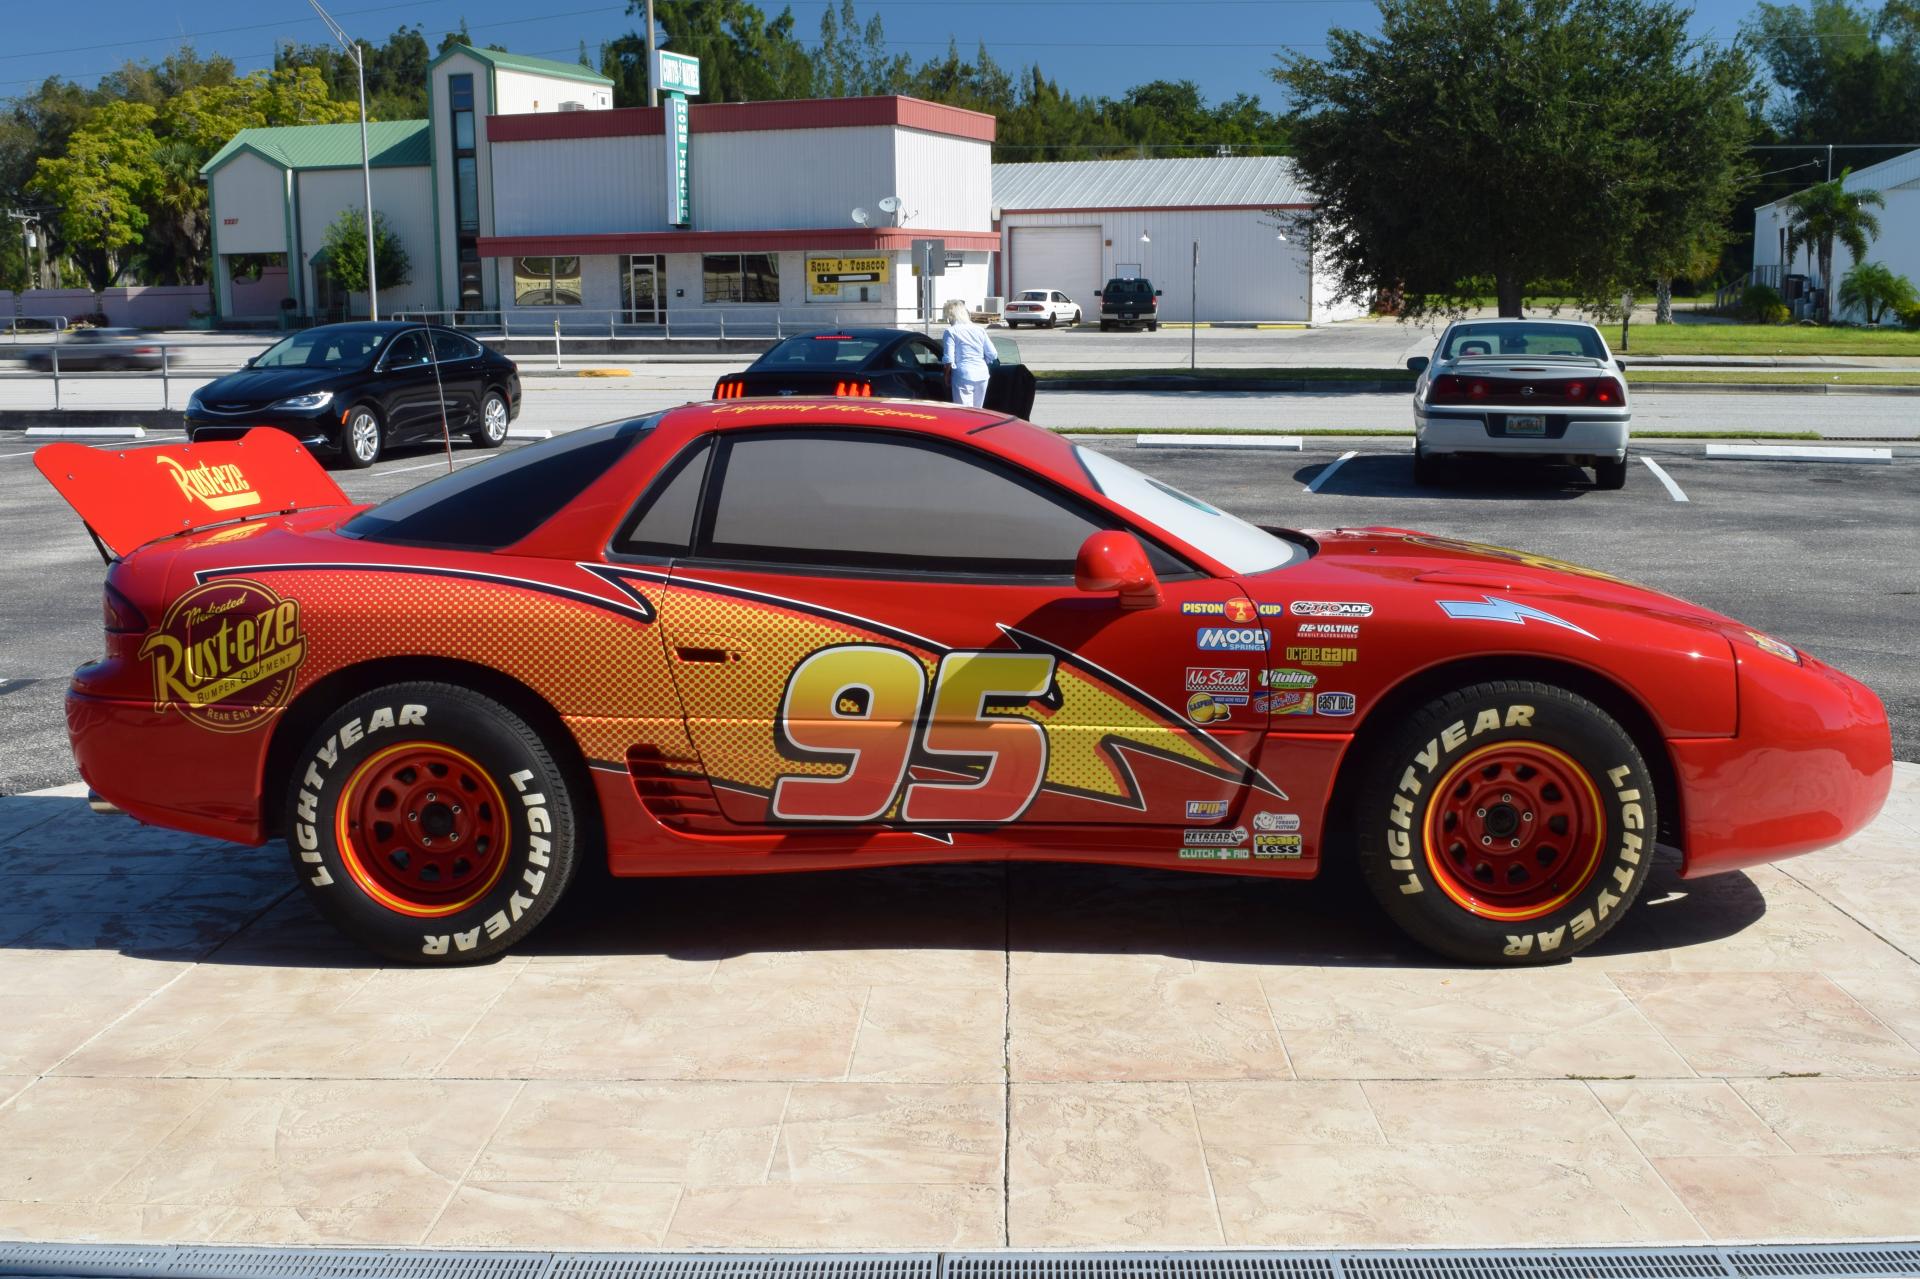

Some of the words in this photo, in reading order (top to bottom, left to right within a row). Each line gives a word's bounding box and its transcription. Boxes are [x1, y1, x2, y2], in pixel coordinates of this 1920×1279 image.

[677, 104, 688, 144] HOME
[679, 149, 689, 218] THEATER
[1182, 603, 1224, 614] PISTON
[1259, 604, 1281, 615] CUP
[1199, 629, 1269, 648] MOOD
[1229, 643, 1266, 652] SPRINGS
[1188, 670, 1208, 685] No
[1207, 670, 1247, 686] Stall
[772, 643, 1057, 824] 95
[295, 703, 428, 887] LIGHTYEAR
[1387, 705, 1535, 895] LIGHTYEAR
[421, 769, 552, 956] LIGHTYEAR
[1179, 849, 1215, 858] CLUTCH
[1503, 764, 1645, 956] LIGHTYEAR
